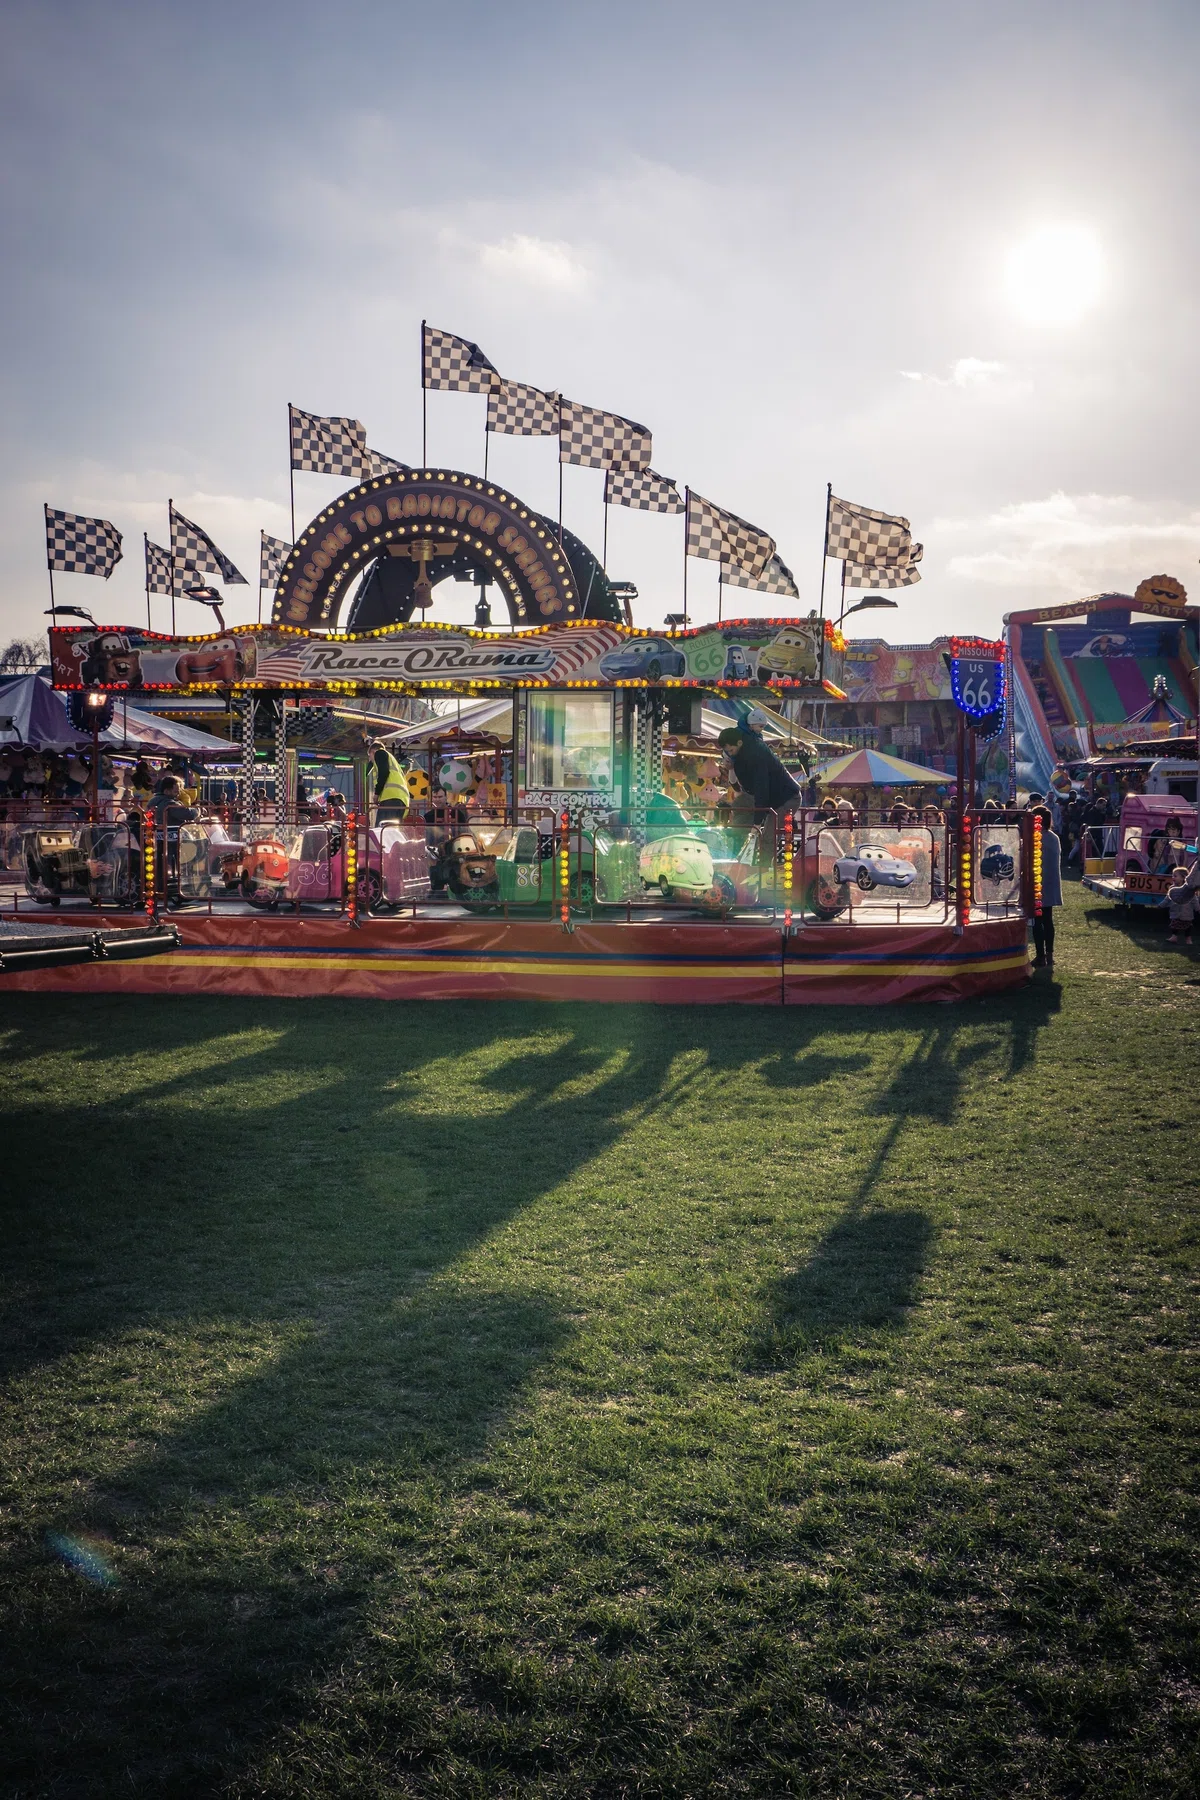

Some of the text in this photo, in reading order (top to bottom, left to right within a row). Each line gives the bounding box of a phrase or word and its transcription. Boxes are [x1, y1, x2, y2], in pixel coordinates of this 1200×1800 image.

[286, 494, 563, 622] WELCOME TO RADIATOR SPRINGS
[1039, 603, 1098, 621] BEACH
[1142, 603, 1194, 617] PARTY
[690, 635, 716, 650] ROUTE
[695, 649, 723, 672] 66
[958, 647, 995, 658] MISSOURI
[969, 663, 984, 674] US
[962, 677, 992, 709] 66
[524, 792, 617, 807] RACE CONTROL
[297, 863, 332, 886] 36
[516, 865, 543, 887] 86
[1130, 877, 1152, 890] BUS
